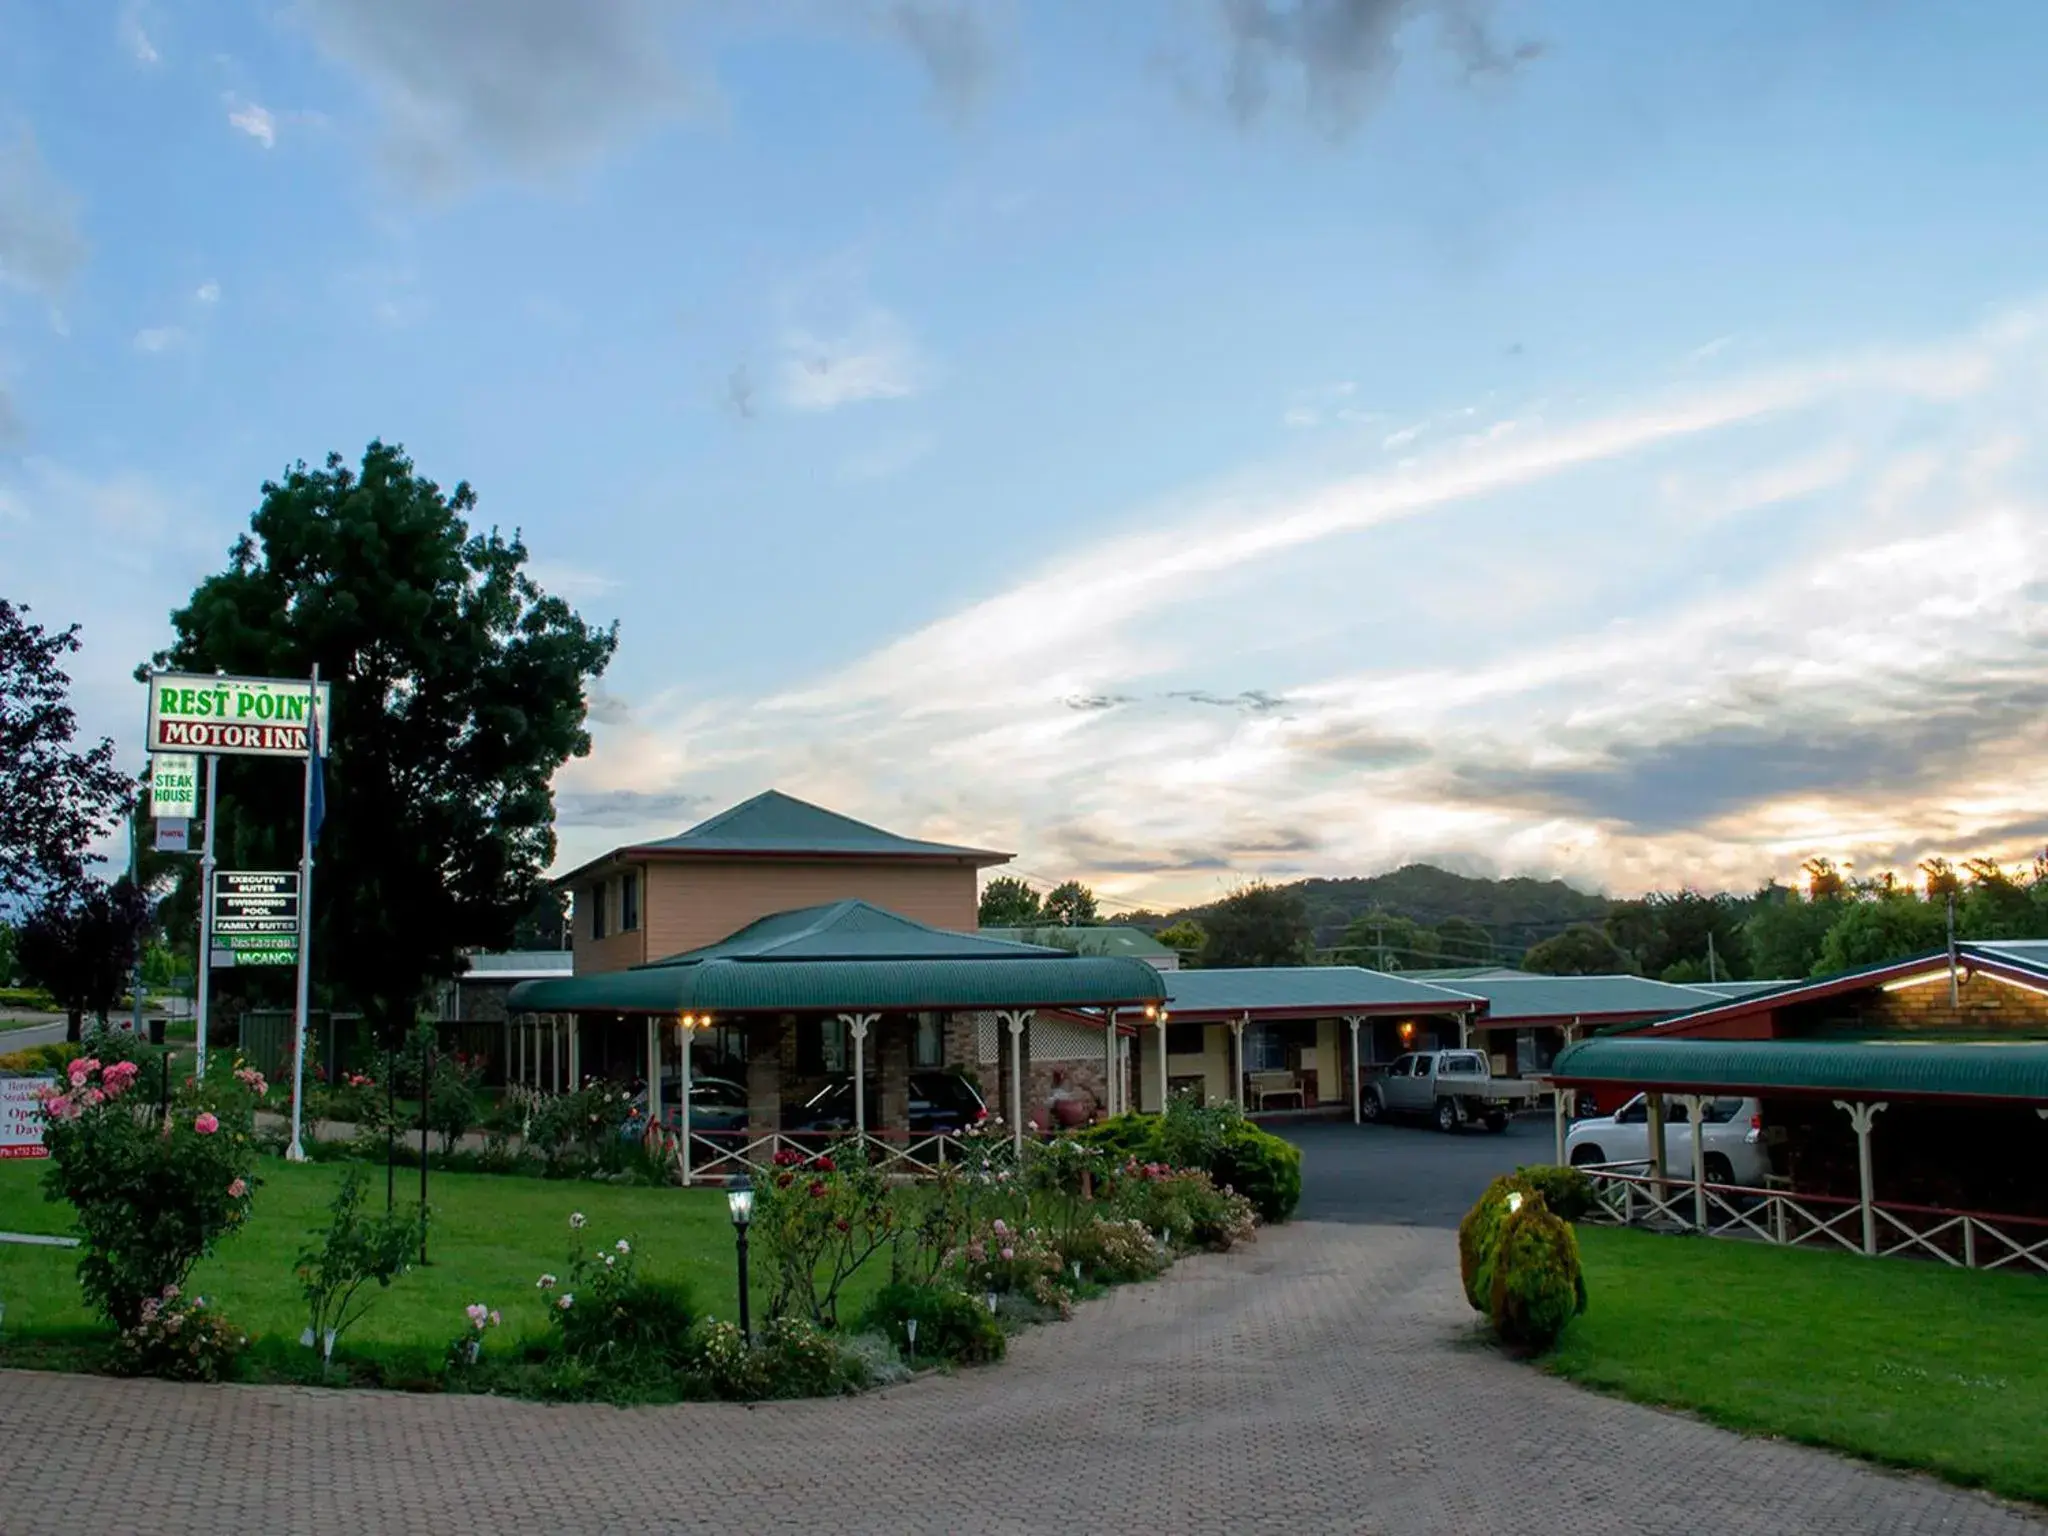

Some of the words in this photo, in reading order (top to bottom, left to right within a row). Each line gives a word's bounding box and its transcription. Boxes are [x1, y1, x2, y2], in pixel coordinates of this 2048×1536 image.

[160, 687, 230, 717] REST
[156, 774, 193, 788] STEAK
[155, 789, 193, 802] HOUSE
[228, 876, 286, 884] EXECUTIVE
[238, 884, 276, 892] SUITES
[227, 899, 287, 907] SWIMMING
[242, 907, 272, 915] POOL
[217, 922, 257, 930] FAMILY
[258, 922, 295, 930] SUITES
[237, 952, 297, 965] VACANCY
[4, 1124, 11, 1135] 7
[15, 1123, 45, 1138] Days
